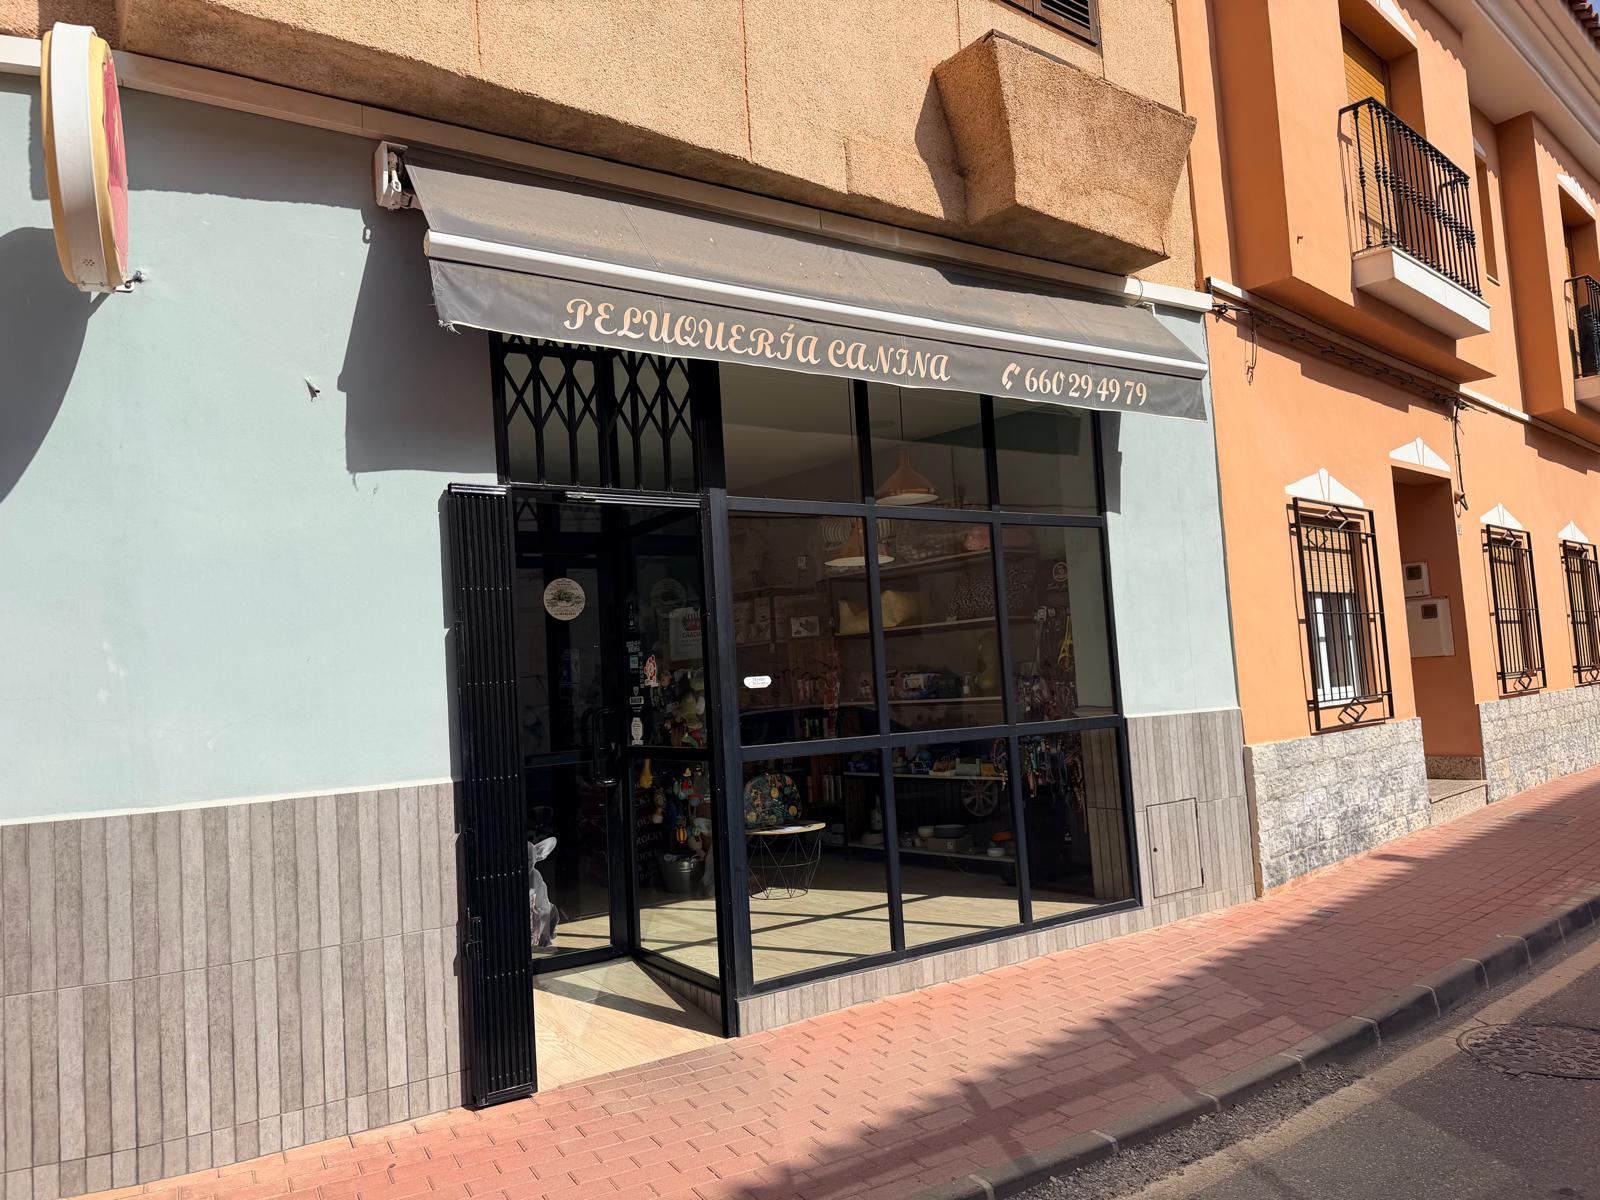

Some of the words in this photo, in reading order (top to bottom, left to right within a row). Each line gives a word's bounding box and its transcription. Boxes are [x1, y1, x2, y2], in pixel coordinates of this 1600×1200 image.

[563, 298, 821, 366] PELUQUERÍA
[827, 339, 951, 382] CANINA
[1024, 367, 1065, 396] 660
